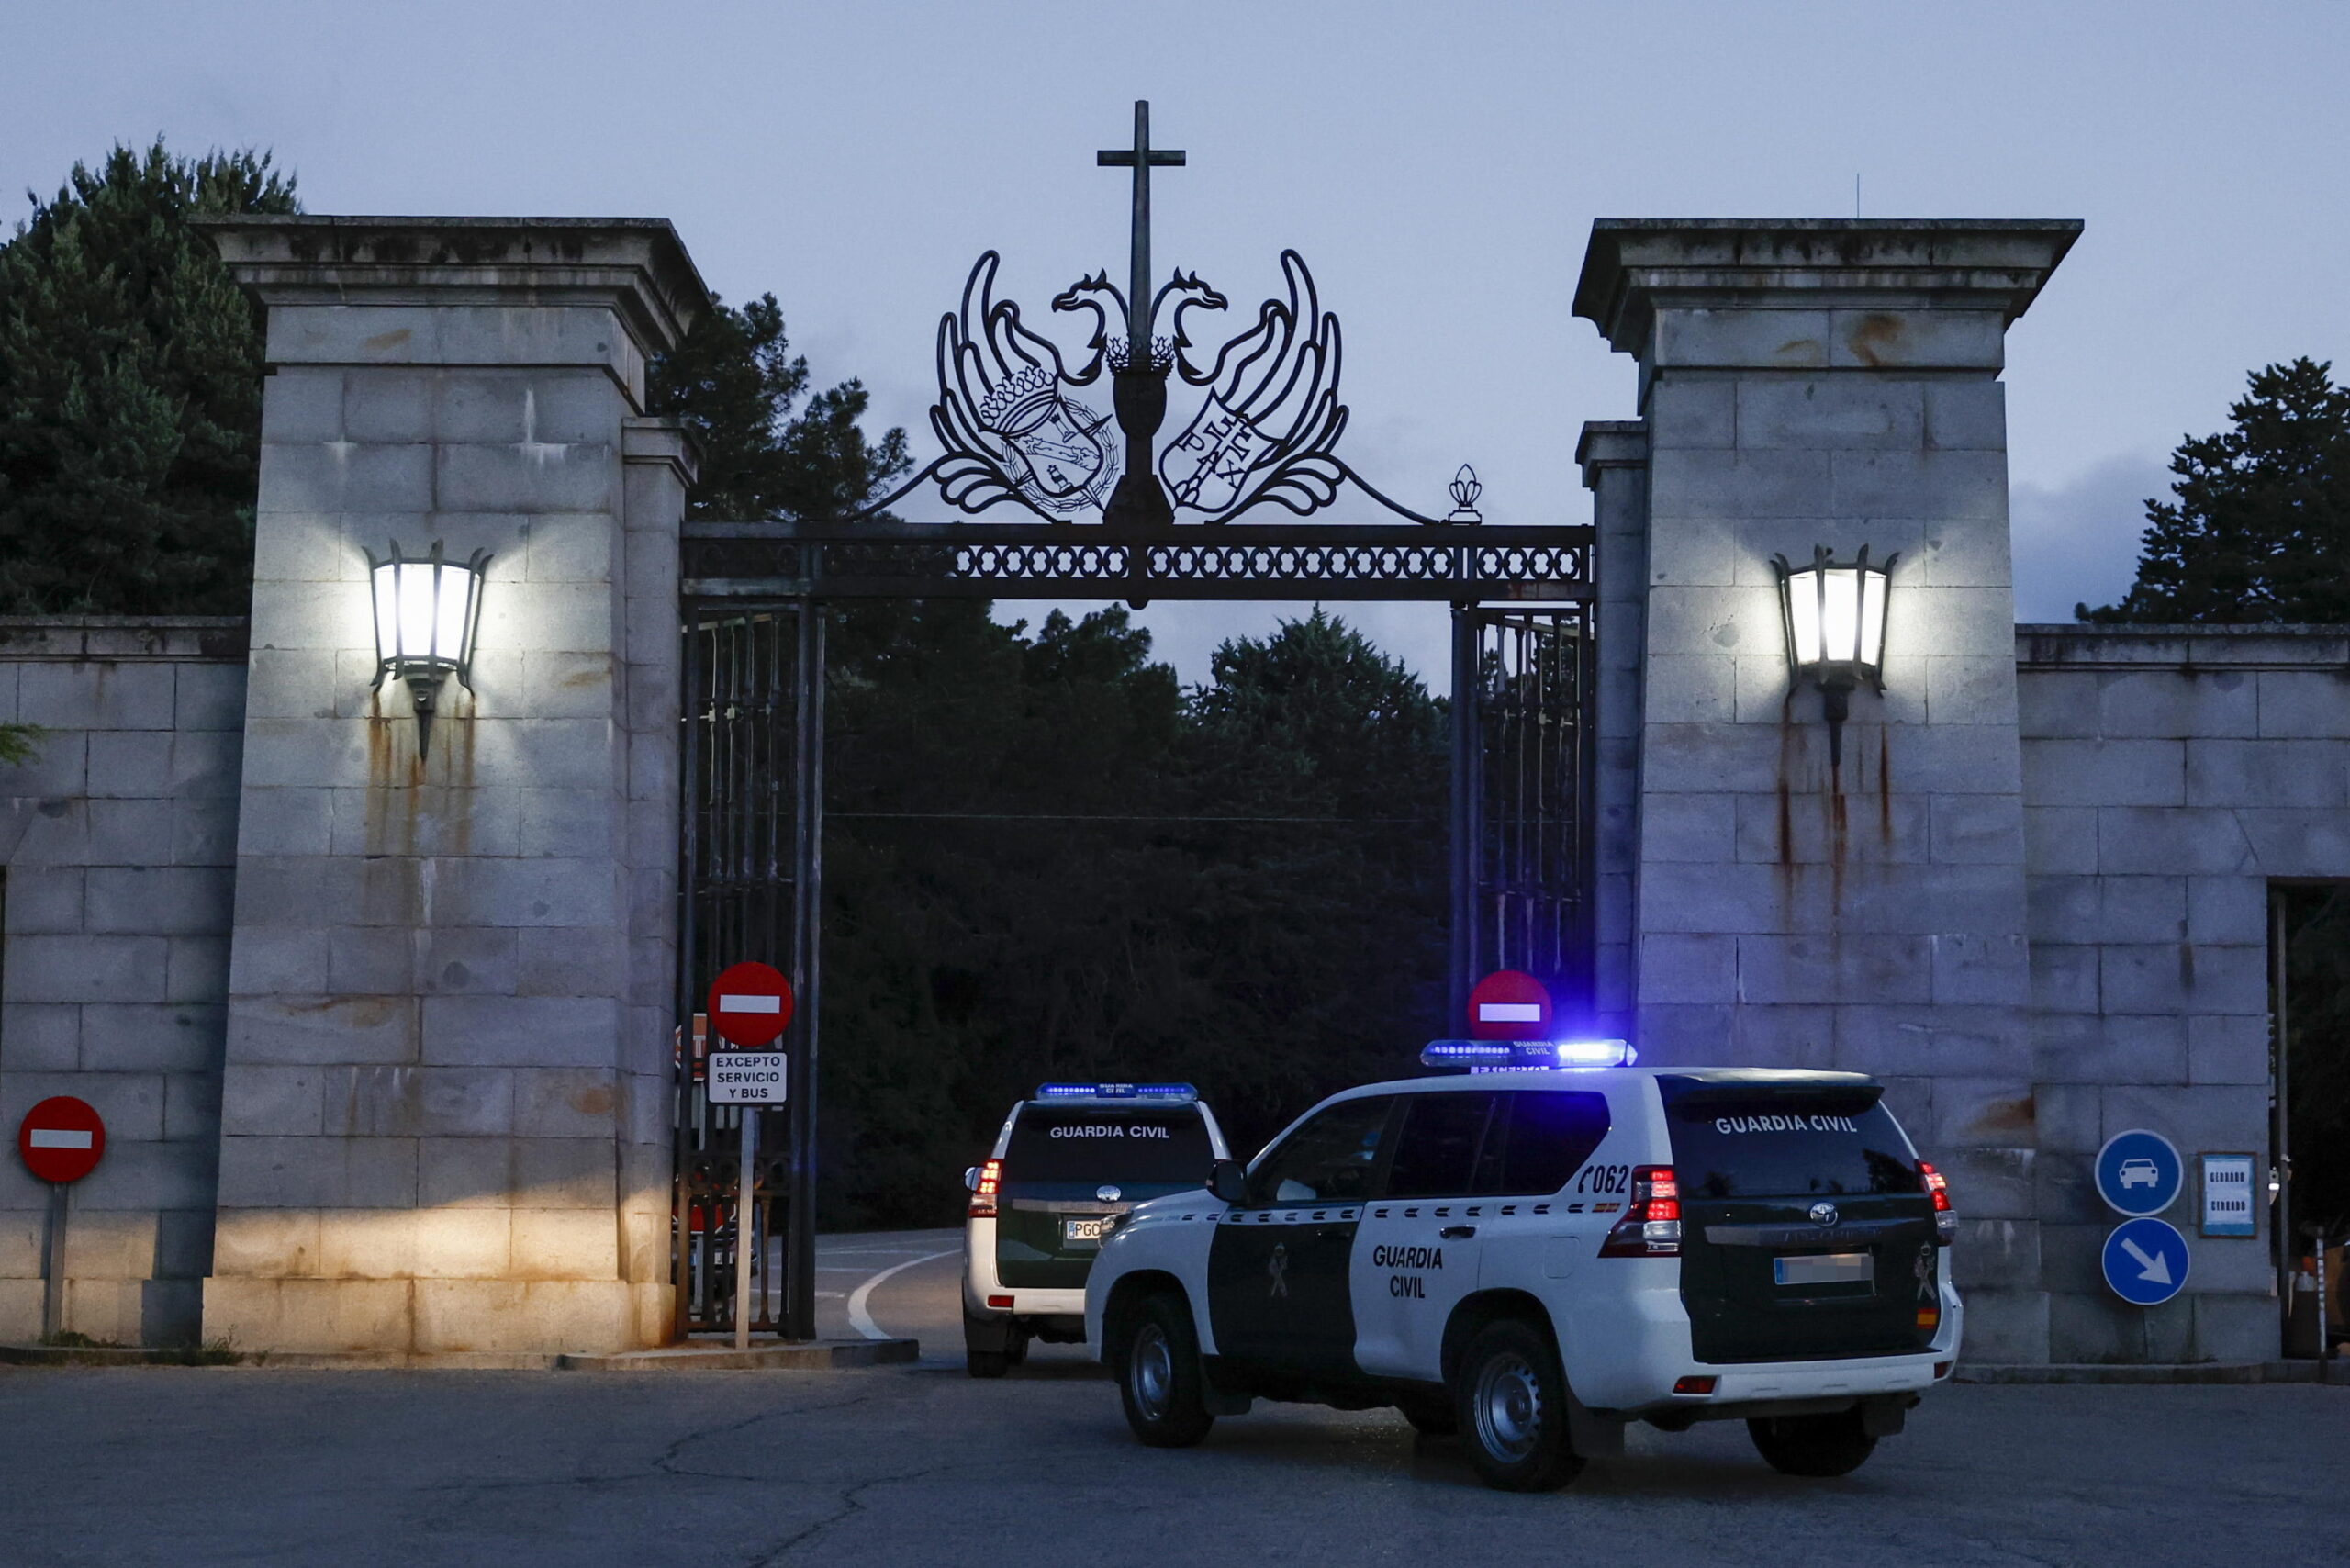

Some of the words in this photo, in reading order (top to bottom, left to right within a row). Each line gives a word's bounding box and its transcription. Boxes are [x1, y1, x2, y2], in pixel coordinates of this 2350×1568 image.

[716, 1056, 780, 1067] EXCEPTO
[717, 1072, 779, 1082] SERVICIO
[729, 1088, 737, 1099] Y
[741, 1088, 768, 1099] BUS
[1050, 1126, 1124, 1137] GUARDIA
[1129, 1126, 1169, 1138] CIVIL
[1716, 1115, 1807, 1134] GUARDIA
[1810, 1115, 1857, 1132] CIVIL
[1593, 1165, 1628, 1193] 062
[1373, 1245, 1442, 1269] GUARDIA
[1390, 1275, 1425, 1298] CIVIL
